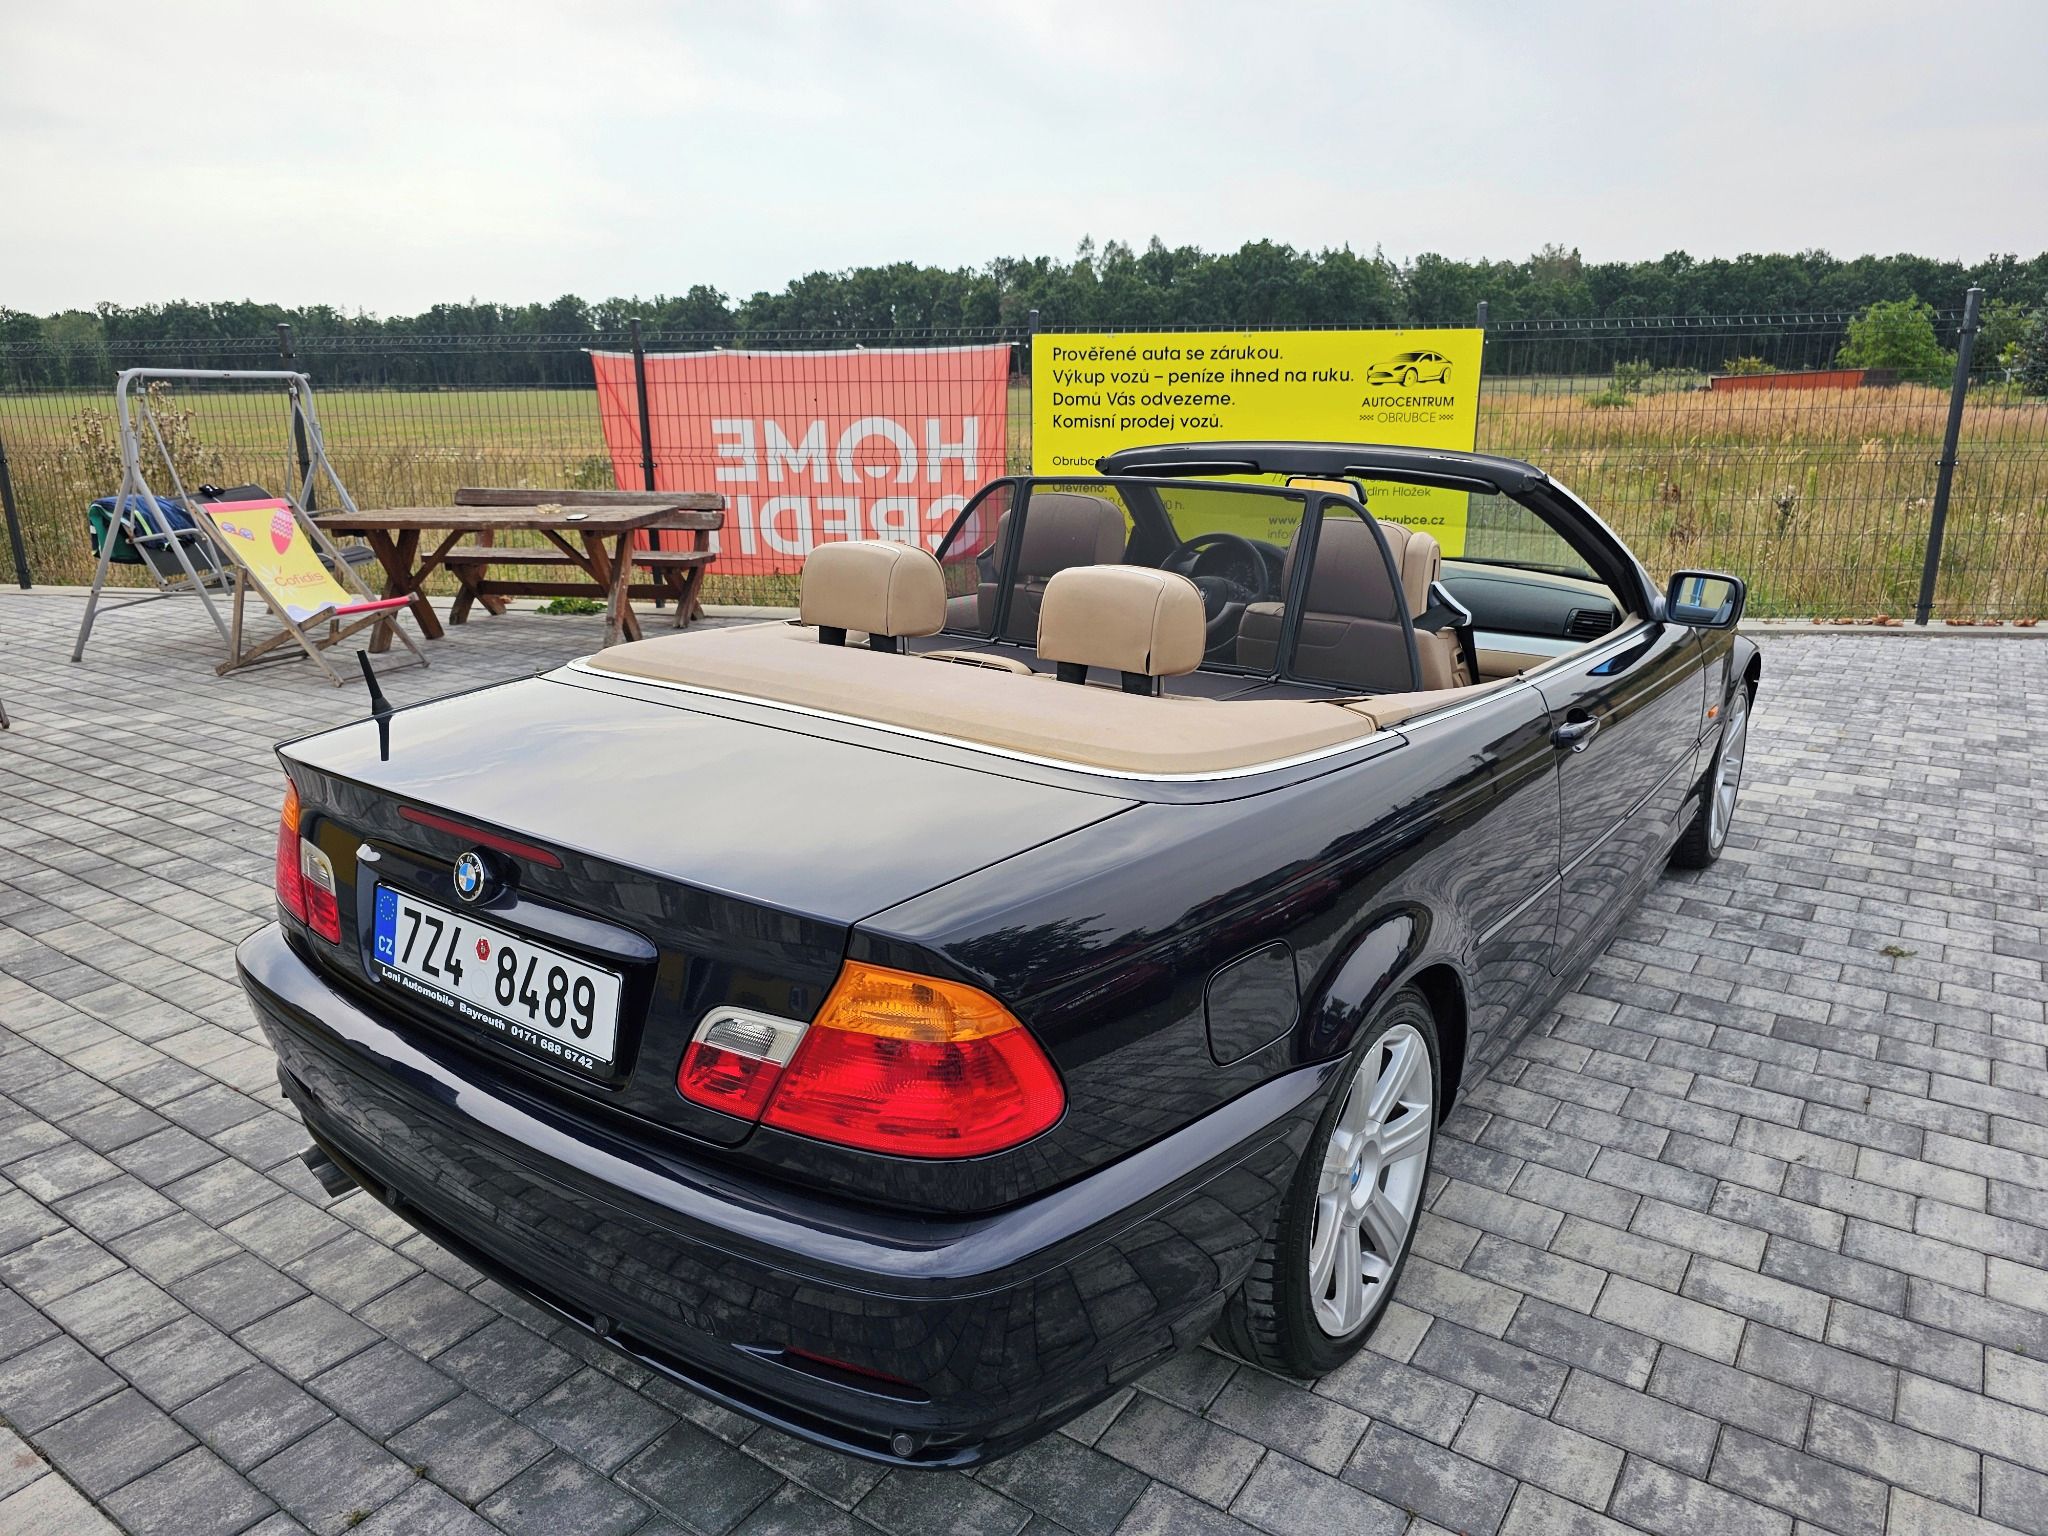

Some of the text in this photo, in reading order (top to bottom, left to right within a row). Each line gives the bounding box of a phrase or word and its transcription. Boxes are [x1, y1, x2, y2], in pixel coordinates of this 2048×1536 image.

[1053, 345, 1283, 361] Prověřené auta se zárukou.
[1053, 369, 1105, 386] Výkup
[1111, 368, 1149, 383] vozů
[1168, 368, 1225, 386] peníze
[1231, 368, 1279, 382] ihned
[1285, 370, 1307, 382] na
[1312, 368, 1354, 382] ruku.
[1053, 391, 1235, 406] Domů Vás odvezeme.
[1361, 396, 1455, 408] AUTOCENTRUM
[1053, 413, 1223, 431] Komisní prodej vozů.
[1377, 412, 1437, 423] OBRUBCE
[1052, 456, 1096, 466] Obrubc
[1392, 486, 1432, 497] Hložek
[274, 570, 325, 588] Cofidis
[378, 935, 393, 955] CZ
[401, 906, 596, 1040] 7Z4 8489
[382, 966, 594, 1070] Loni Automobile Bayreuth 0171 688 6742
